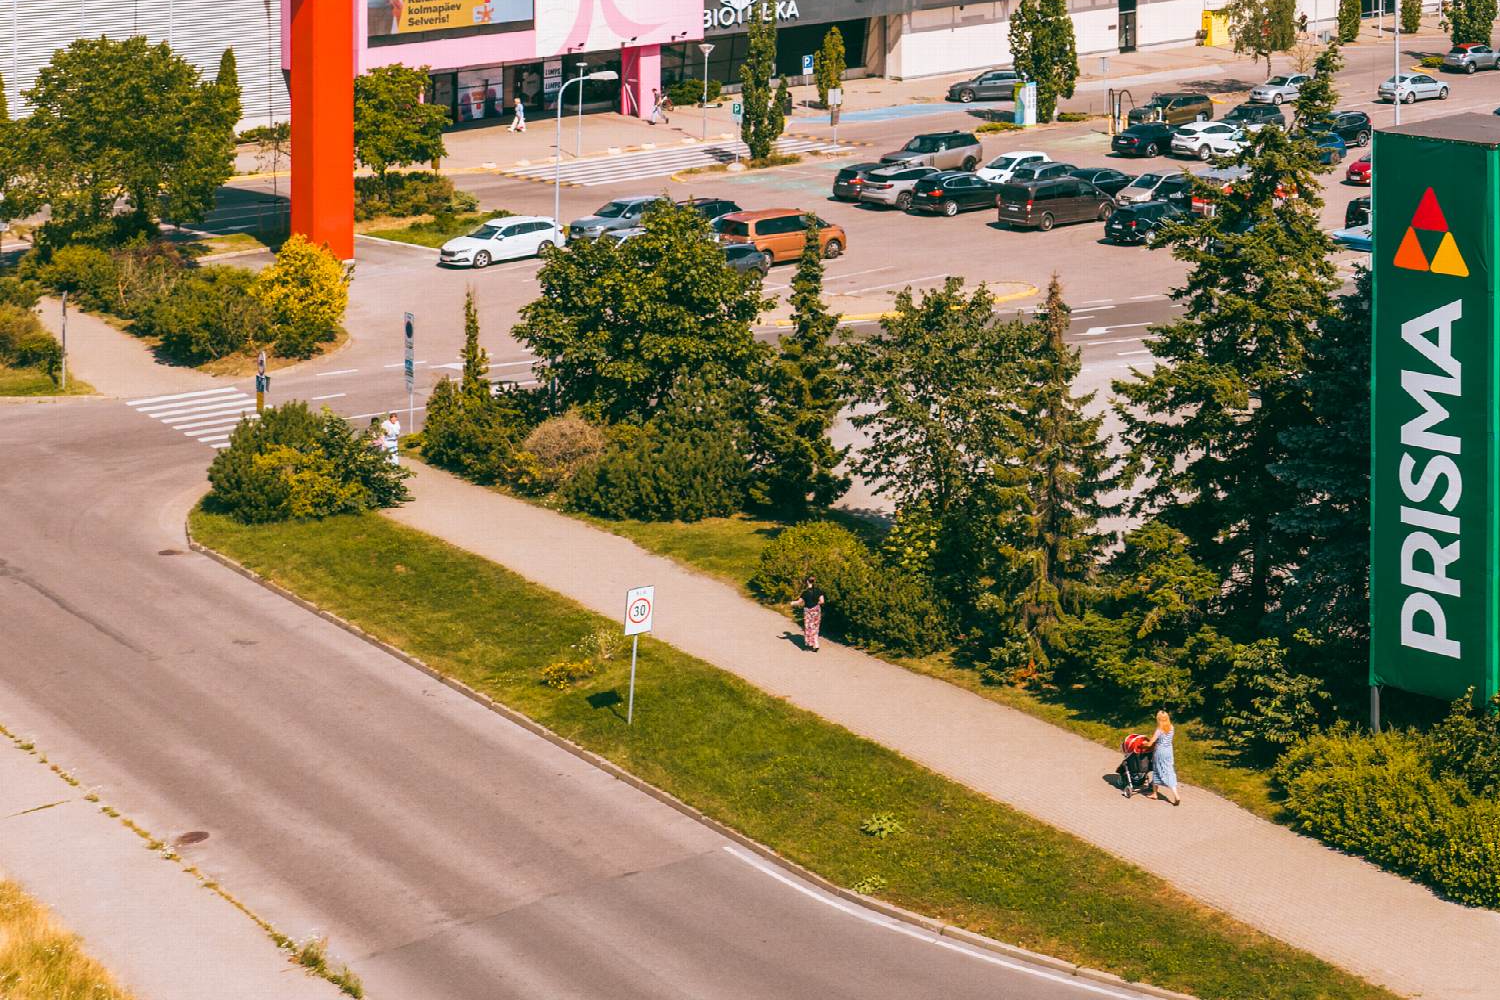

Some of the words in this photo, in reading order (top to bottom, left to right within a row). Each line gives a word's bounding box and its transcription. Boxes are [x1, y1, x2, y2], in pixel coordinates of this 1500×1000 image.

[408, 3, 462, 18] kolmapäev
[1399, 298, 1463, 660] PRISMA
[633, 604, 646, 617] 30
